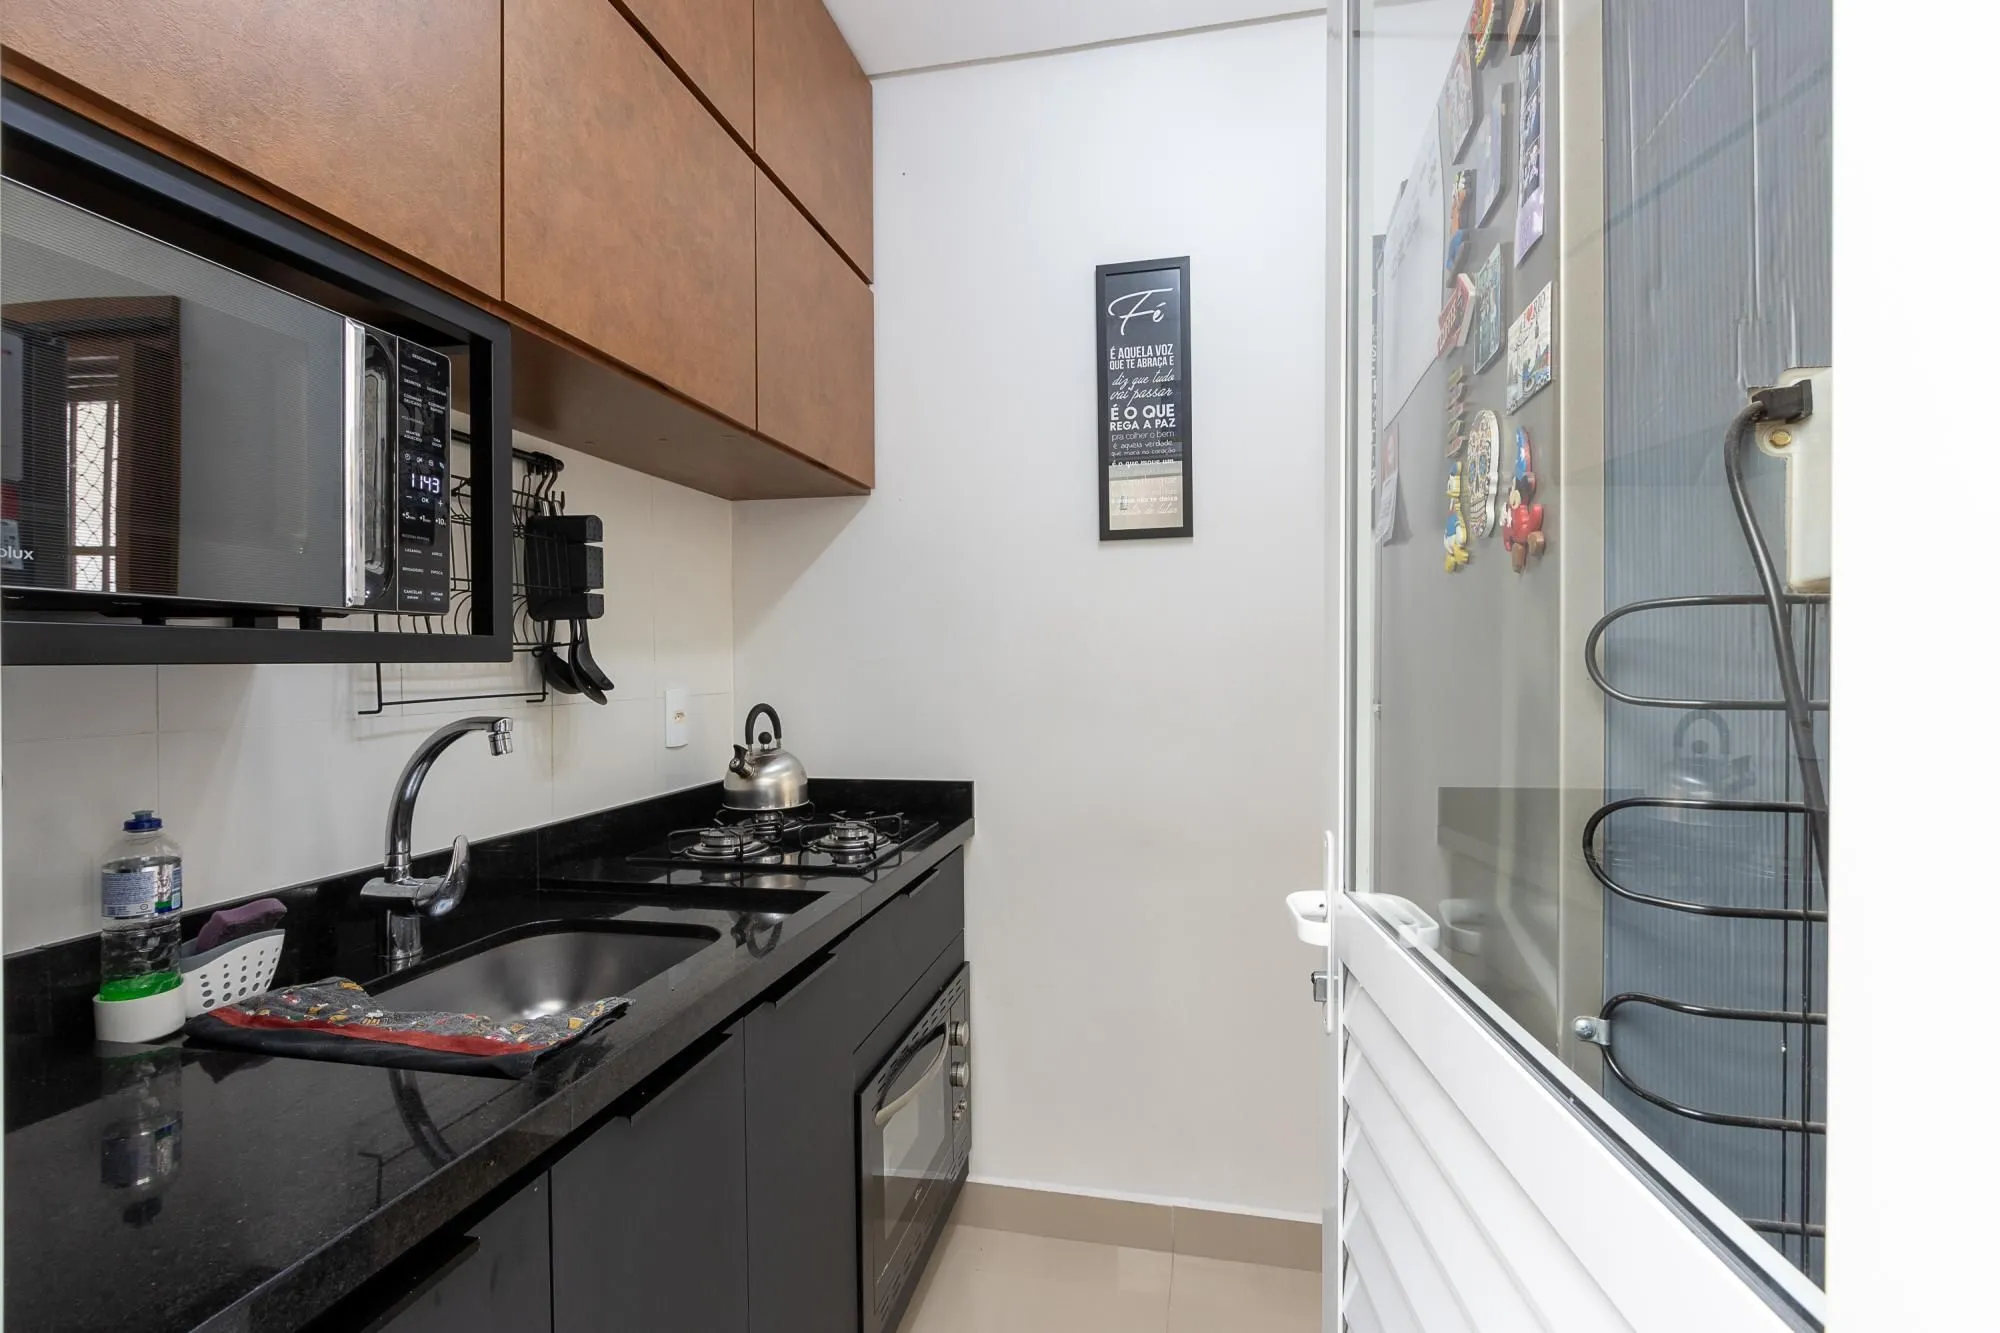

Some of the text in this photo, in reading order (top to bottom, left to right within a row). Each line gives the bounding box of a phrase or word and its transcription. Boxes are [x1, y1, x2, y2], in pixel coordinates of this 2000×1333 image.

[1107, 287, 1174, 336] Fé
[1110, 343, 1174, 360] É AQUELA VOZ
[1109, 356, 1175, 370] QUE TE ABRAÇA E
[1112, 368, 1175, 391] diz que tudo
[1110, 387, 1174, 407] vai passar
[1111, 404, 1175, 420] É O QUE
[1110, 418, 1176, 431] REGA A PAZ
[1156, 430, 1175, 438] bem
[411, 473, 440, 494] 1143
